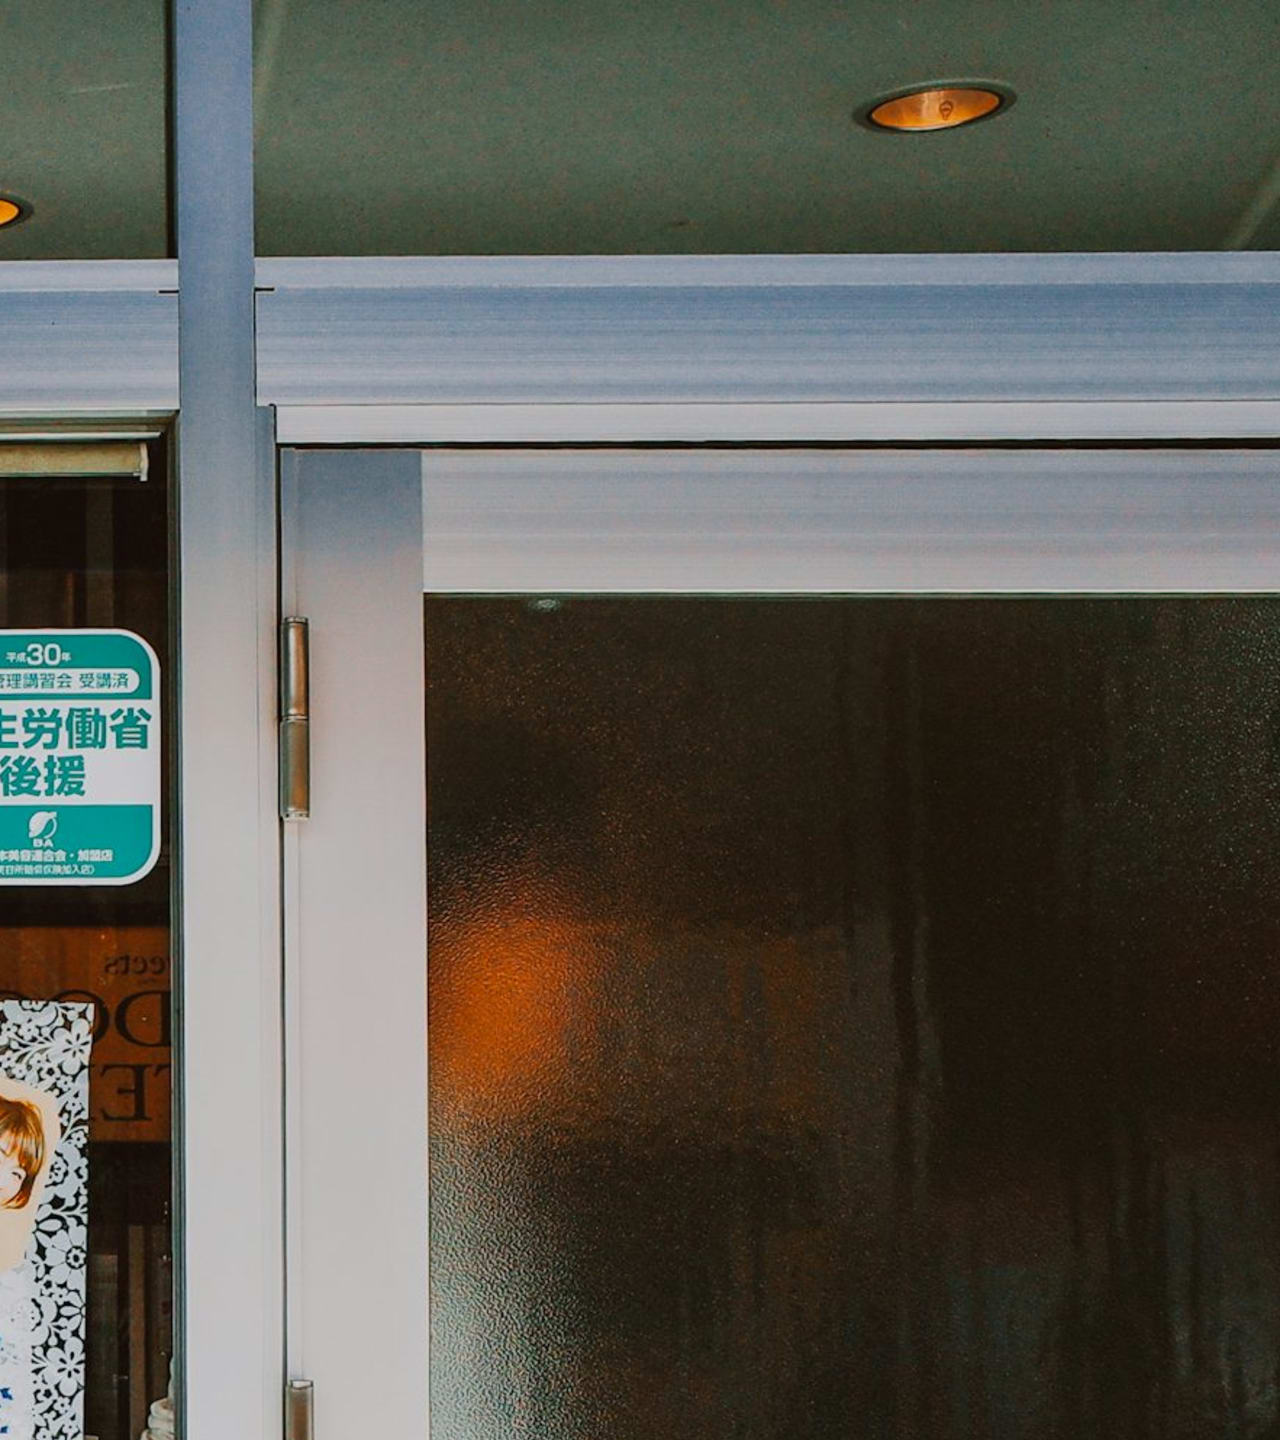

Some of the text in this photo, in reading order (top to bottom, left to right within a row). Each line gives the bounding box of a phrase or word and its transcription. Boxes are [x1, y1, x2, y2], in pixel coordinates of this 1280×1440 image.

[6, 643, 71, 666] 平成30年
[79, 672, 129, 690] 受講済
[0, 754, 86, 797] 後援
